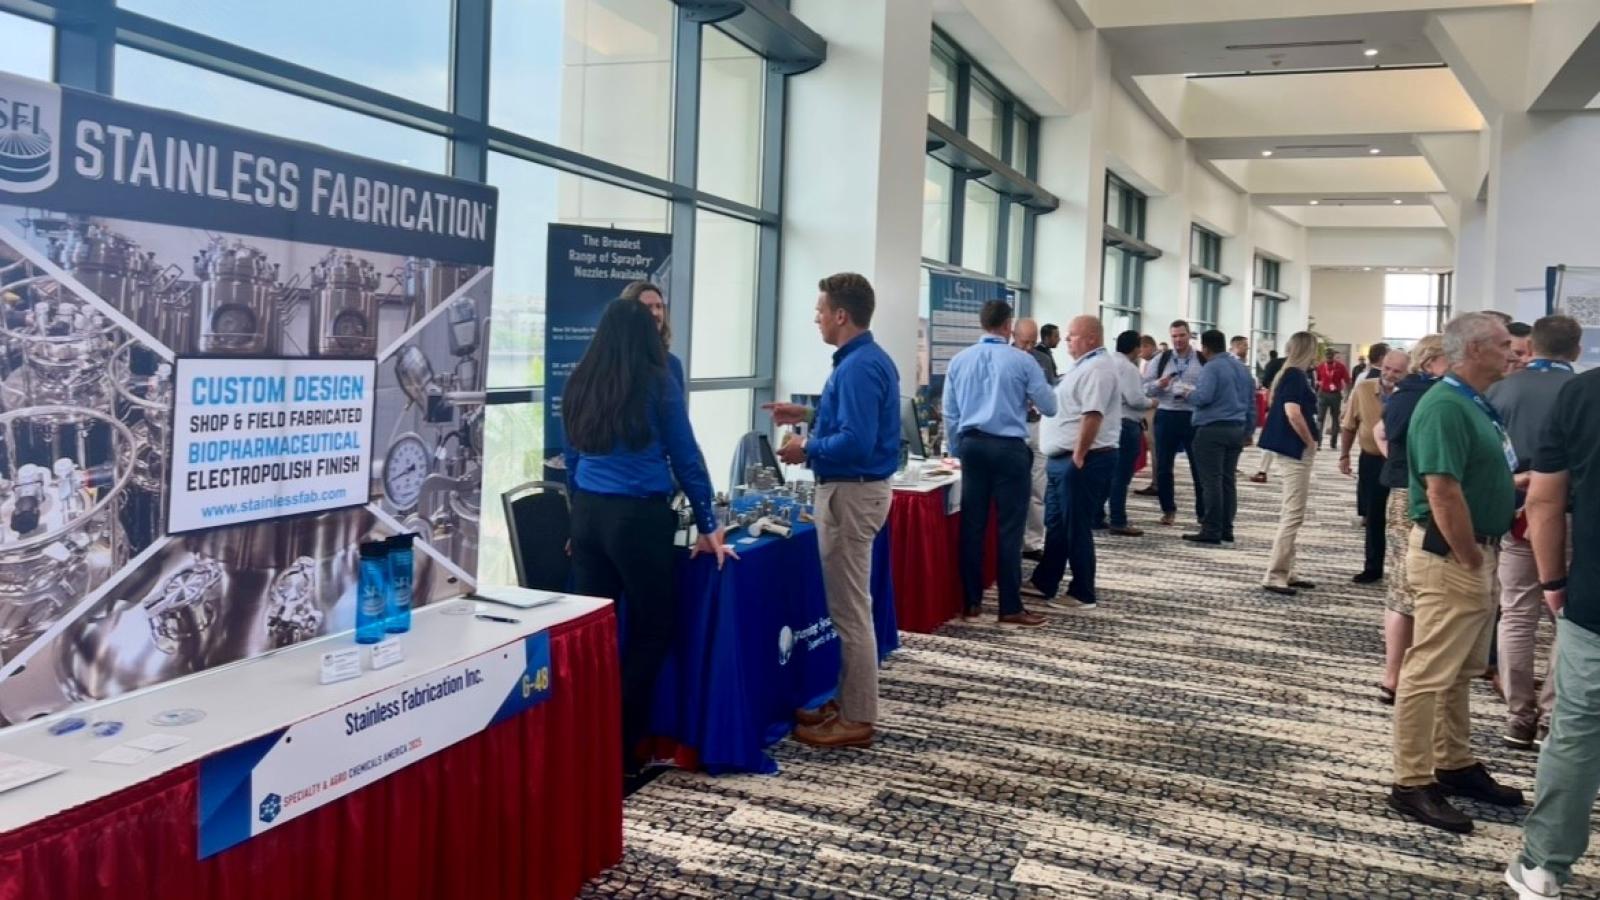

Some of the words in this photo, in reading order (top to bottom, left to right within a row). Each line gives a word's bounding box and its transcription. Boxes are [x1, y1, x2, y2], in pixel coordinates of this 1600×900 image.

[75, 119, 299, 211] STAINLESS
[311, 167, 487, 241] FABRICATION
[569, 249, 597, 264] Range
[600, 252, 609, 263] of
[583, 234, 600, 247] The
[602, 236, 641, 250] Broadest
[574, 266, 608, 279] Nozzles
[610, 267, 648, 280] Available
[192, 376, 286, 405] CUSTOM
[294, 375, 364, 401] DESIGN
[190, 414, 229, 433] SHOP
[234, 413, 242, 430] &
[248, 411, 285, 429] FIELD
[290, 408, 362, 426] FABRICATED
[188, 431, 360, 463] BIOPHARMACEUTICAL
[187, 462, 311, 491] ELECTROPOLISH
[317, 455, 360, 476] FINISH
[202, 488, 346, 517] www.stainlessfab.com
[522, 666, 549, 698] G-48
[345, 698, 400, 736] Stainless
[401, 674, 464, 713] Fabrication
[465, 668, 484, 689] Inc.
[283, 783, 321, 807] SPECIALTY
[329, 771, 347, 786] AGRO
[348, 755, 383, 779] CHEMICALS
[383, 744, 408, 762] AMERICA
